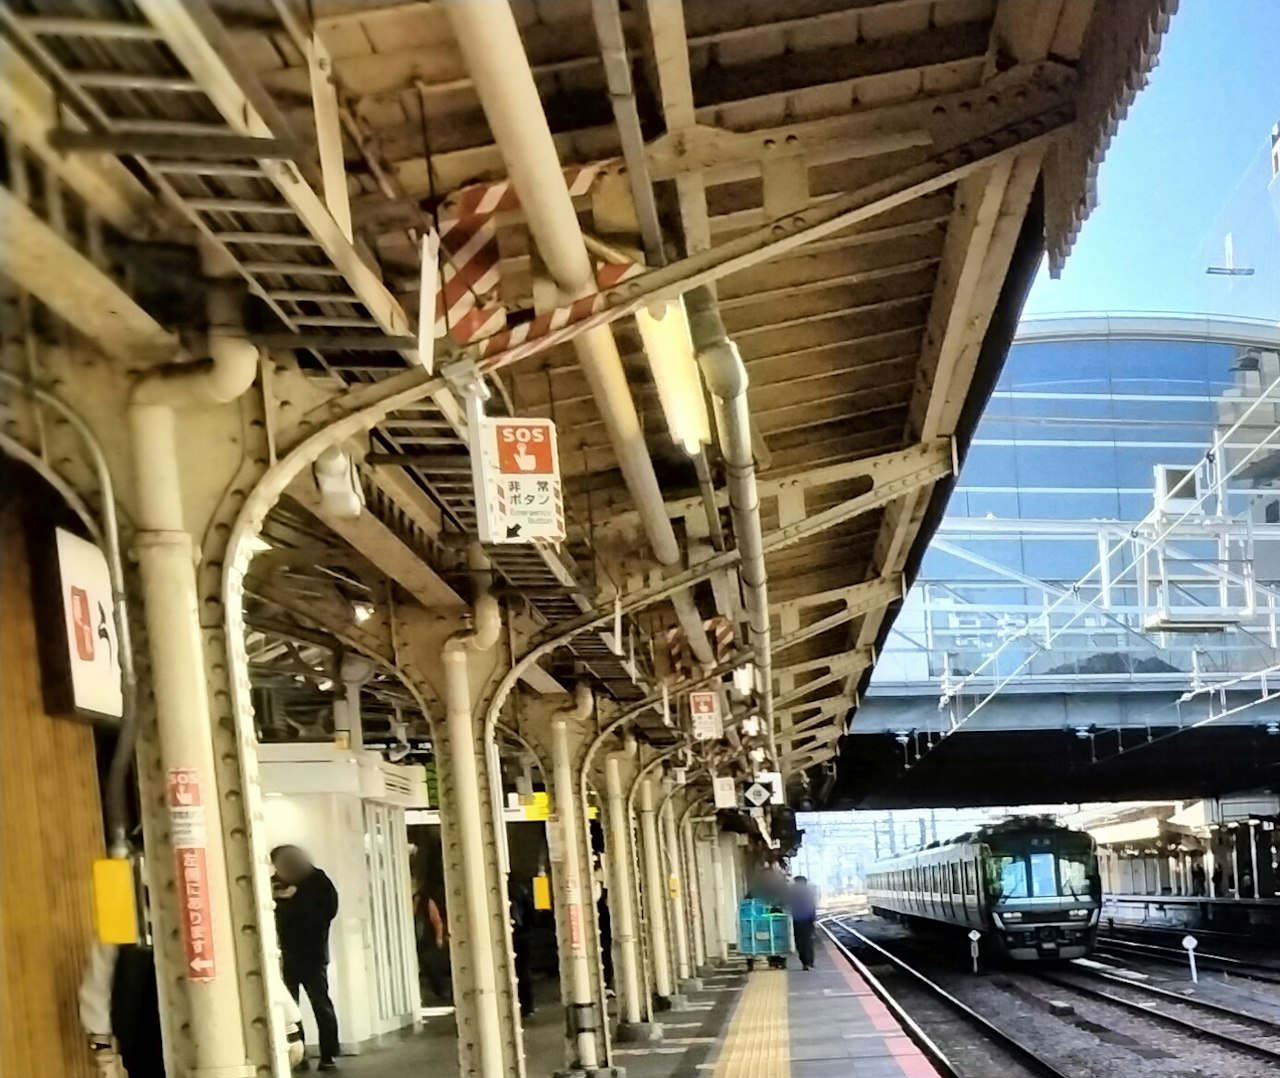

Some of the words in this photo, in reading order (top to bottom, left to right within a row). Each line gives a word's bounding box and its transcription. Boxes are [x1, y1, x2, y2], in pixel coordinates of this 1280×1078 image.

[502, 428, 545, 442] SOS
[510, 494, 549, 505] ボタン
